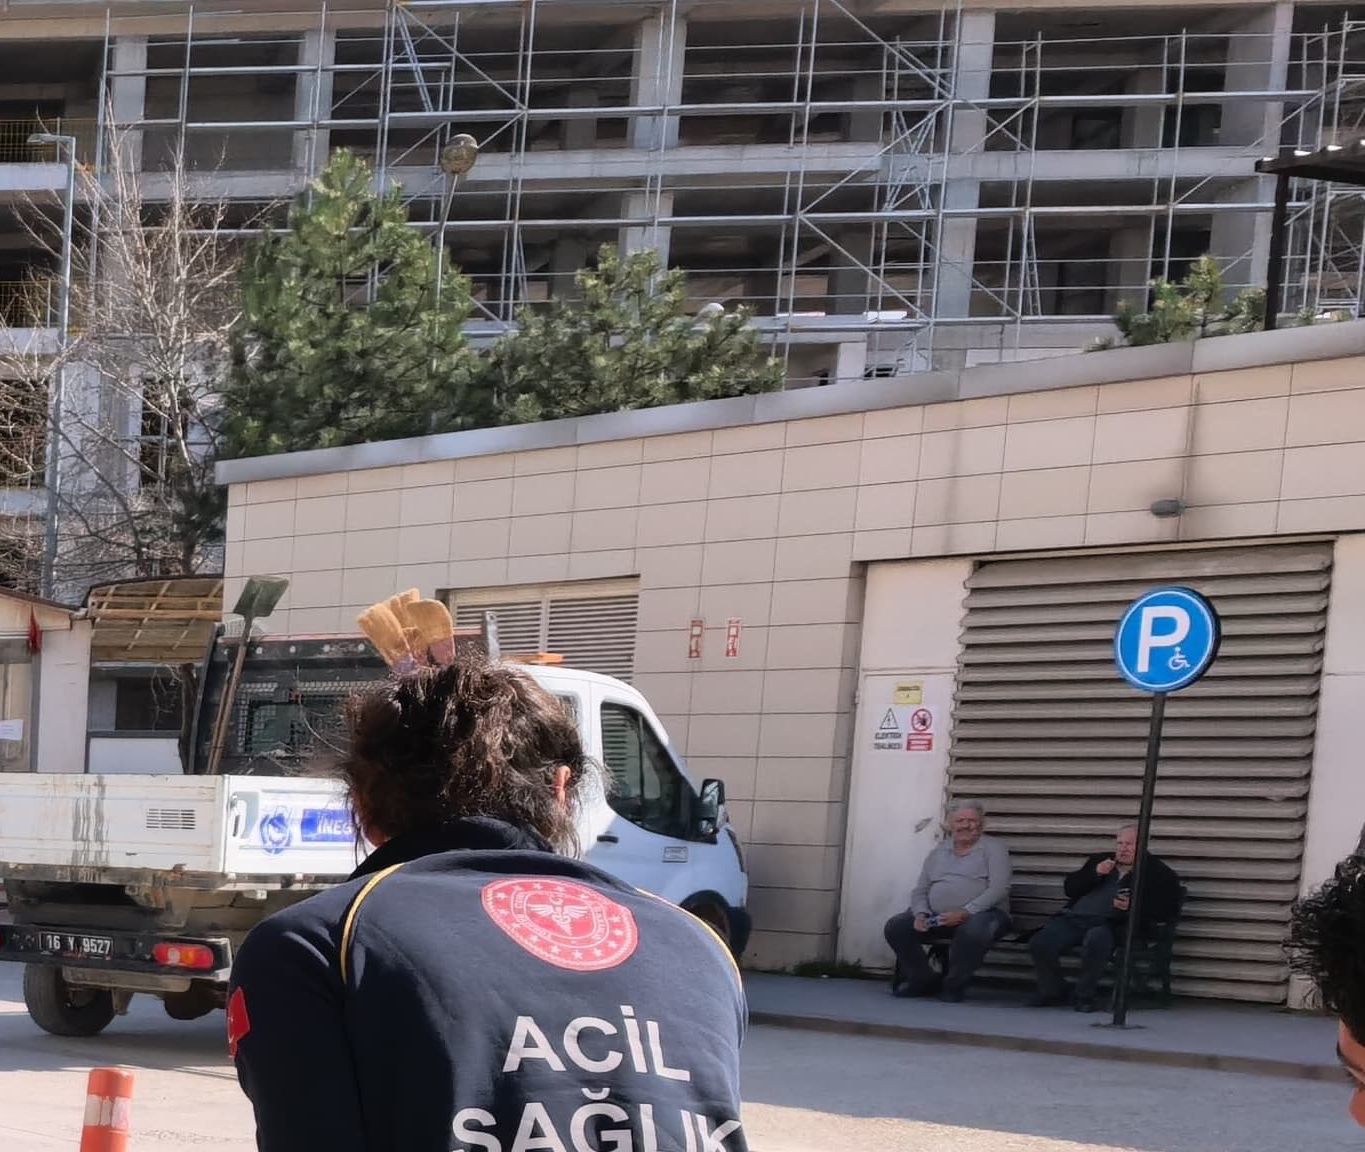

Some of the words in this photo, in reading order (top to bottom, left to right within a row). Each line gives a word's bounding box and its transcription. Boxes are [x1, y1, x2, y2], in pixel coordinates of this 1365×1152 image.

[1137, 605, 1191, 673] P
[46, 934, 62, 950] 16
[82, 938, 111, 955] 9527
